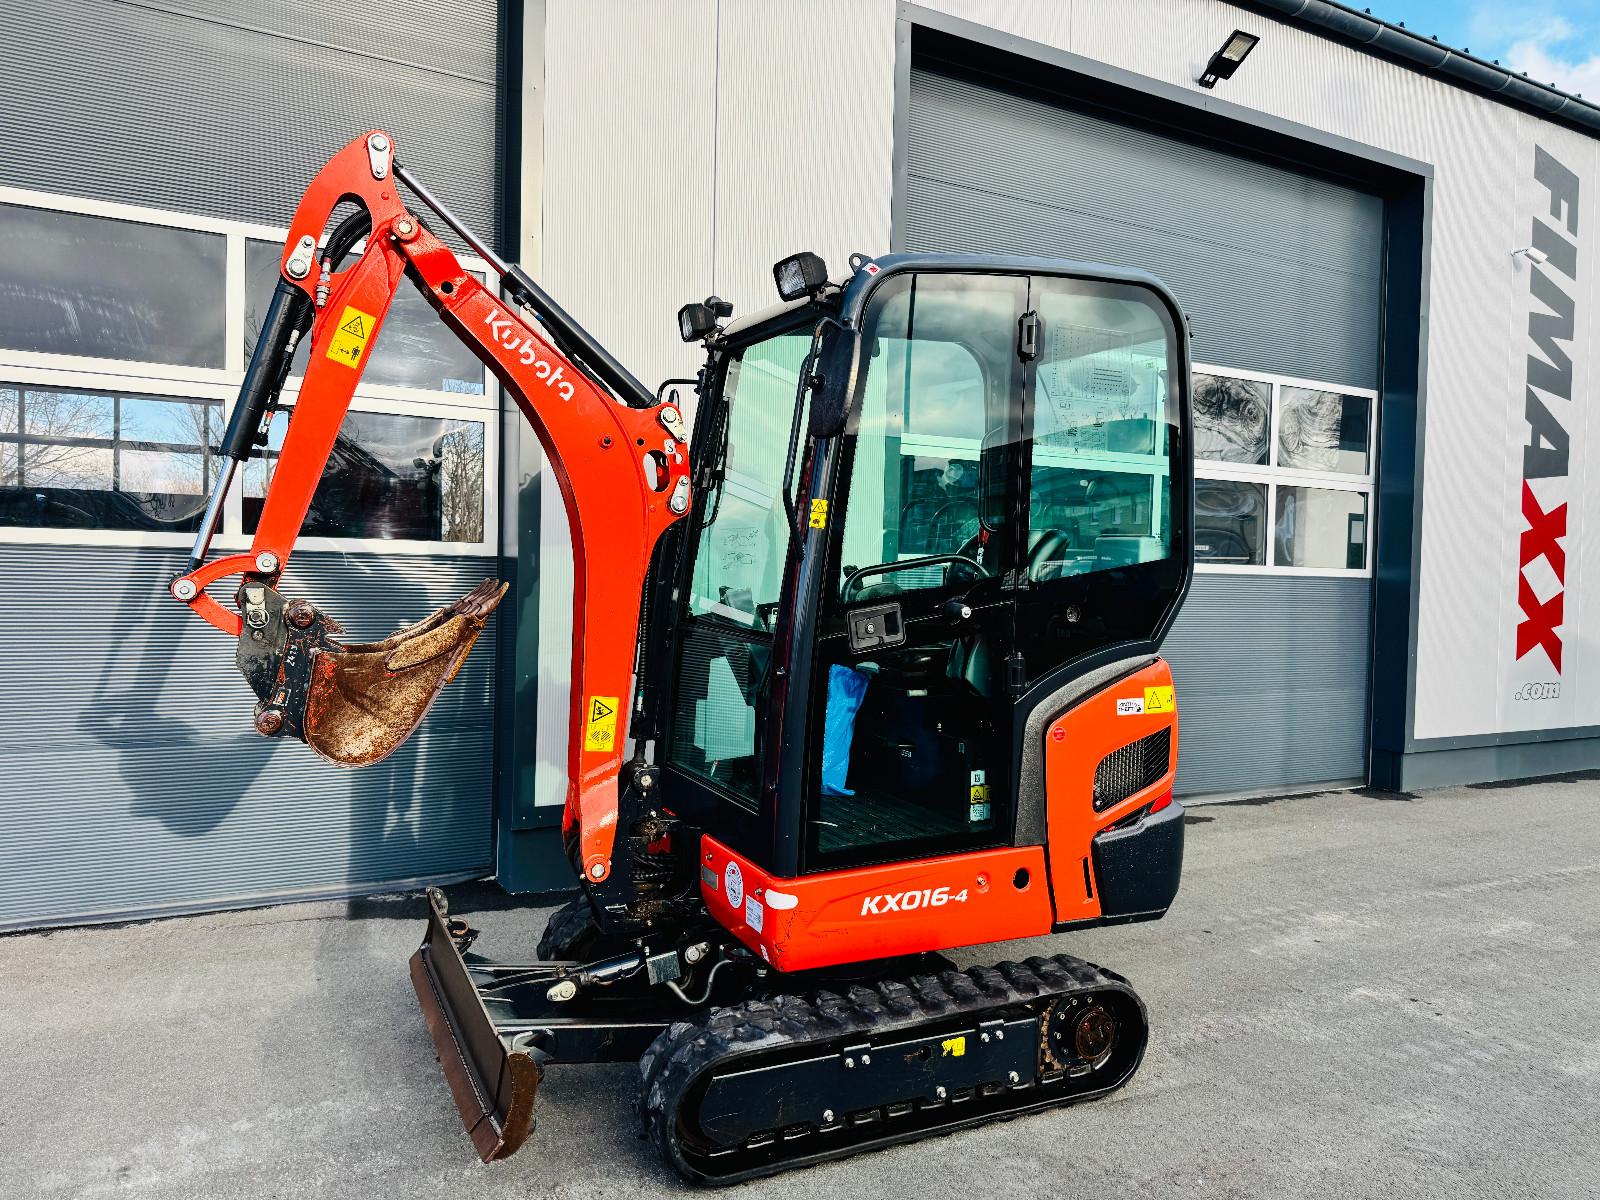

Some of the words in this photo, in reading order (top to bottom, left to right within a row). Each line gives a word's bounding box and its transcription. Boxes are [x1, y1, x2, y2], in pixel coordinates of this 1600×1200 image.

[485, 309, 575, 401] Kubota
[1516, 143, 1580, 676] FIMAXX
[1514, 682, 1561, 701] .com
[860, 887, 968, 916] KX016-4
